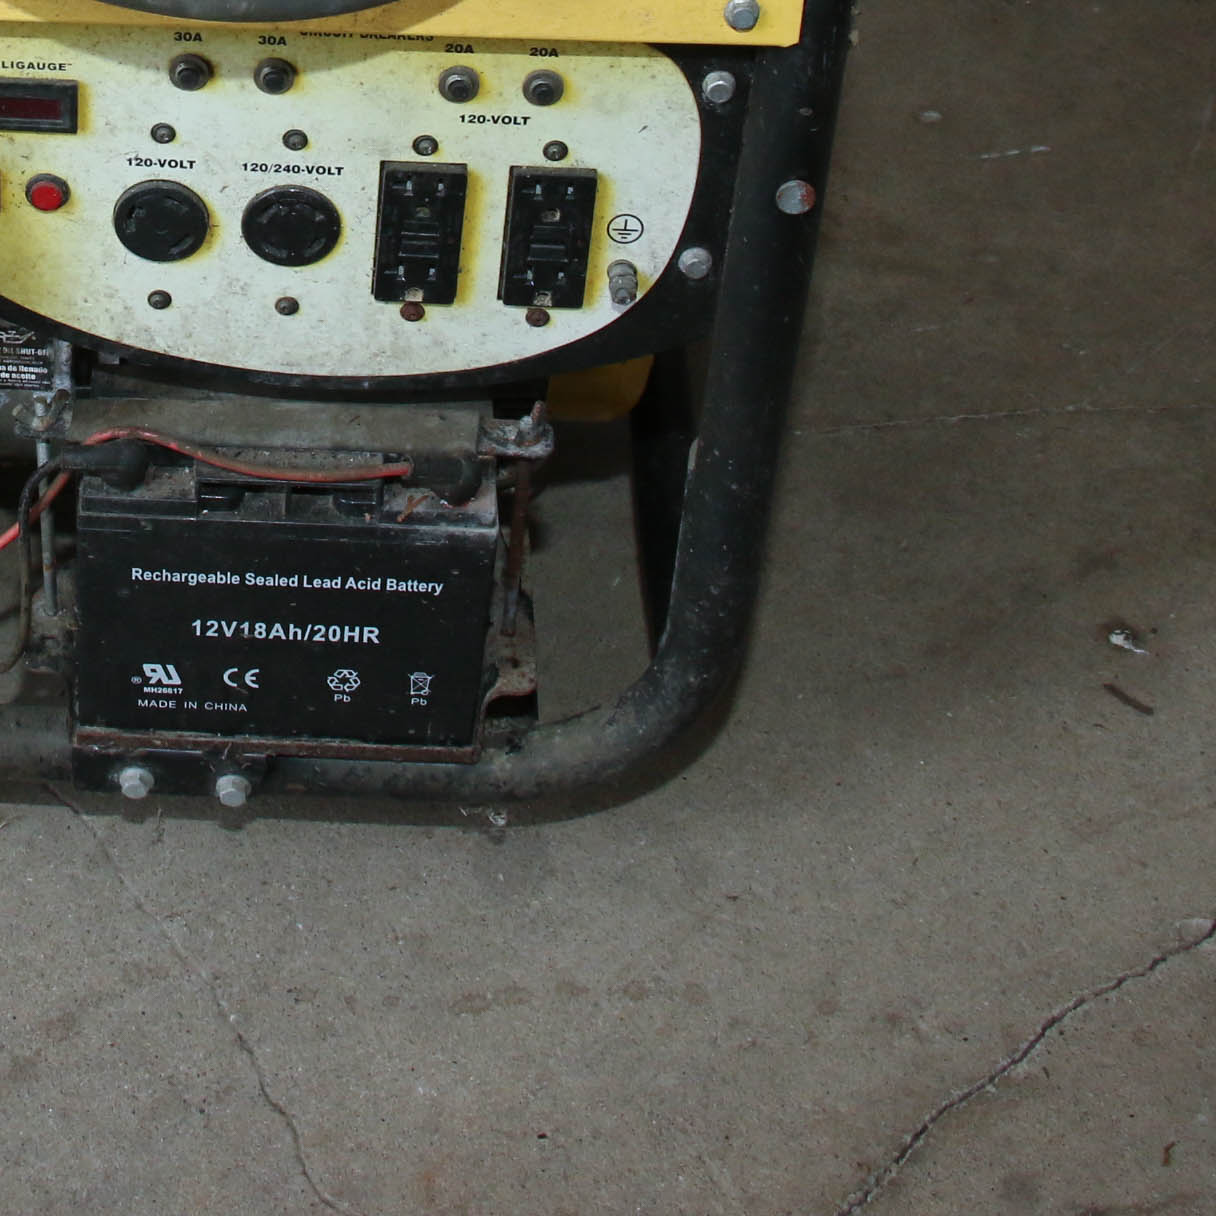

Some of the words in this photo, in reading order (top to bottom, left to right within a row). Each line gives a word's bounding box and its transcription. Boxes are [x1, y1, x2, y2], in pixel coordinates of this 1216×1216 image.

[174, 32, 203, 43] 30A
[258, 35, 287, 47] 30A
[445, 44, 475, 54] 20A
[529, 47, 559, 58] 20A
[459, 114, 531, 126] 120-VOLT
[126, 158, 197, 170] 120-VOLT
[242, 162, 345, 176] 120/240-VOLT
[131, 568, 241, 586] Rechargeable
[245, 572, 298, 588] Sealed
[303, 574, 342, 590] Lead
[345, 576, 381, 591] Acid
[385, 578, 444, 596] Battery
[191, 619, 381, 644] 12V18Ah/20HR
[224, 668, 260, 689] CE
[334, 693, 351, 703] Pb
[410, 698, 428, 706] Pb
[138, 698, 177, 709] MADE
[184, 701, 198, 710] IN
[204, 702, 248, 712] CHINA
